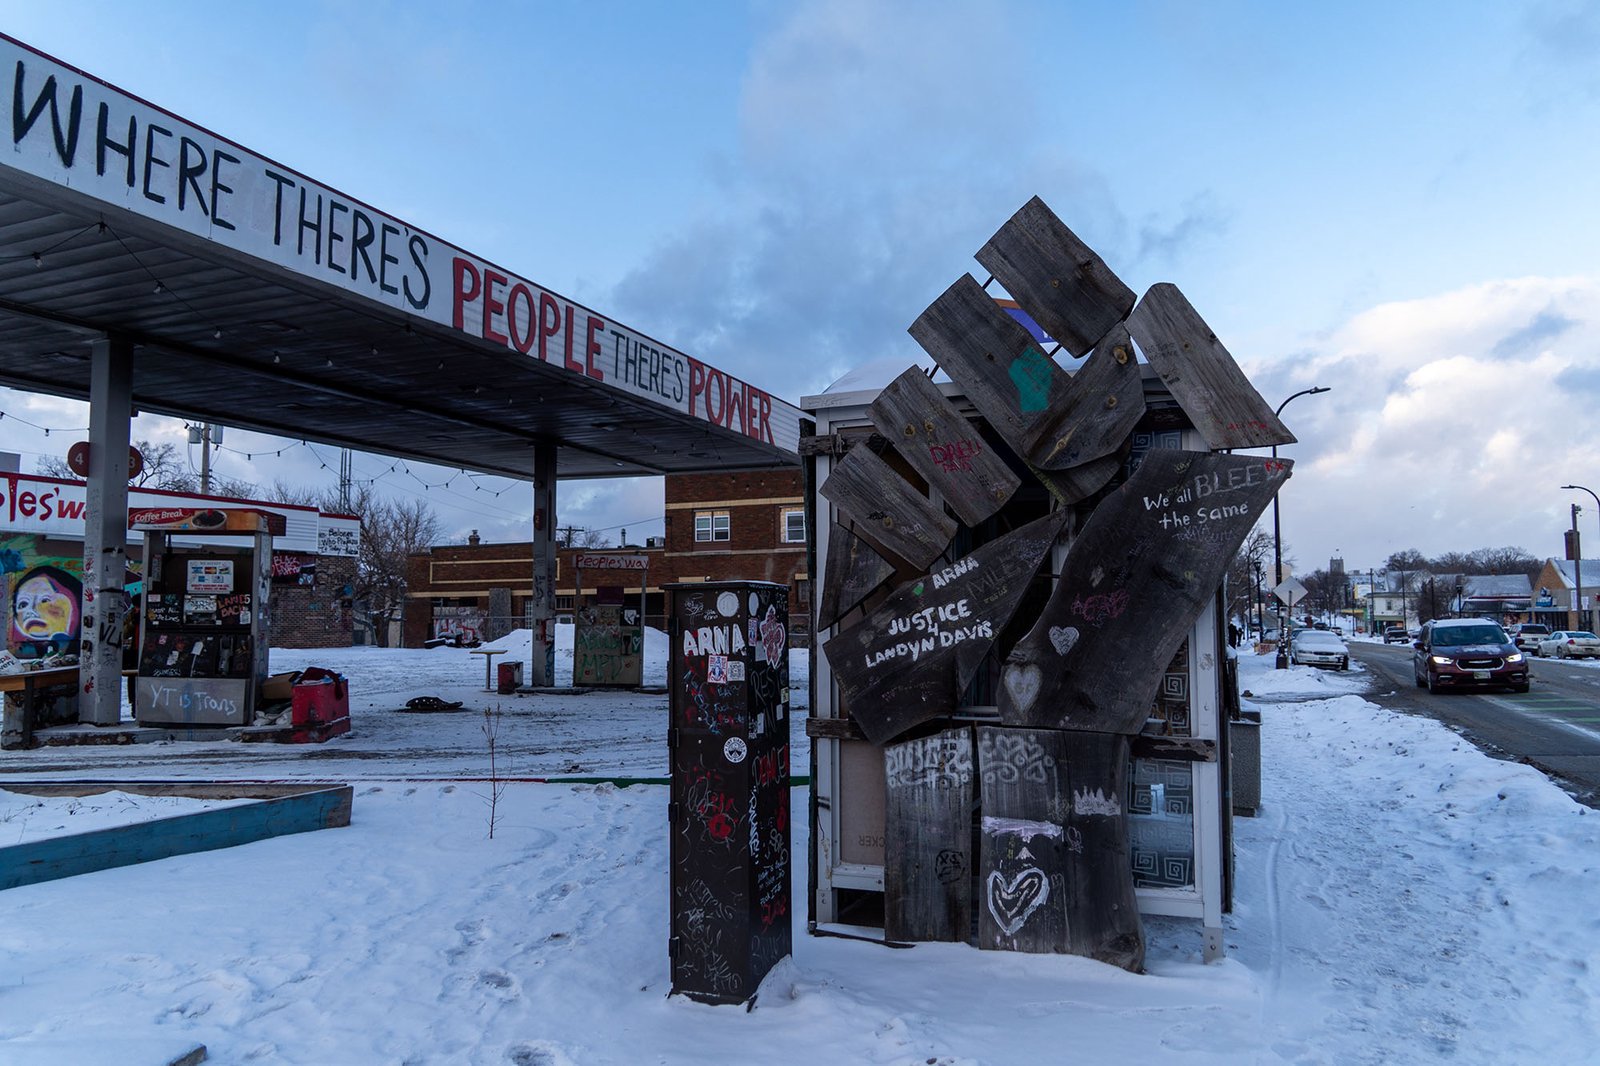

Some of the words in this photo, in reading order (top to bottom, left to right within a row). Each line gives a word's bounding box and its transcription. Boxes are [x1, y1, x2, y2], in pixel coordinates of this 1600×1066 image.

[13, 60, 241, 231] WHERE
[265, 169, 431, 310] THERE'S
[453, 256, 605, 382] PEOPLE
[610, 329, 684, 403] THERE'S
[687, 356, 776, 446] POWER
[75, 452, 84, 466] 4
[129, 456, 136, 469] 3
[0, 478, 87, 522] les'w
[1142, 492, 1170, 511] We
[1176, 488, 1192, 505] all
[134, 512, 160, 524] Coffee
[160, 508, 184, 520] Break
[1158, 511, 1191, 530] the
[932, 556, 980, 590] ARNA
[888, 598, 973, 636] JUSTICE
[926, 622, 939, 637] 4
[683, 623, 747, 657] ARNA
[864, 635, 935, 669] LANDYN
[150, 684, 177, 708] YT
[179, 693, 192, 709] is
